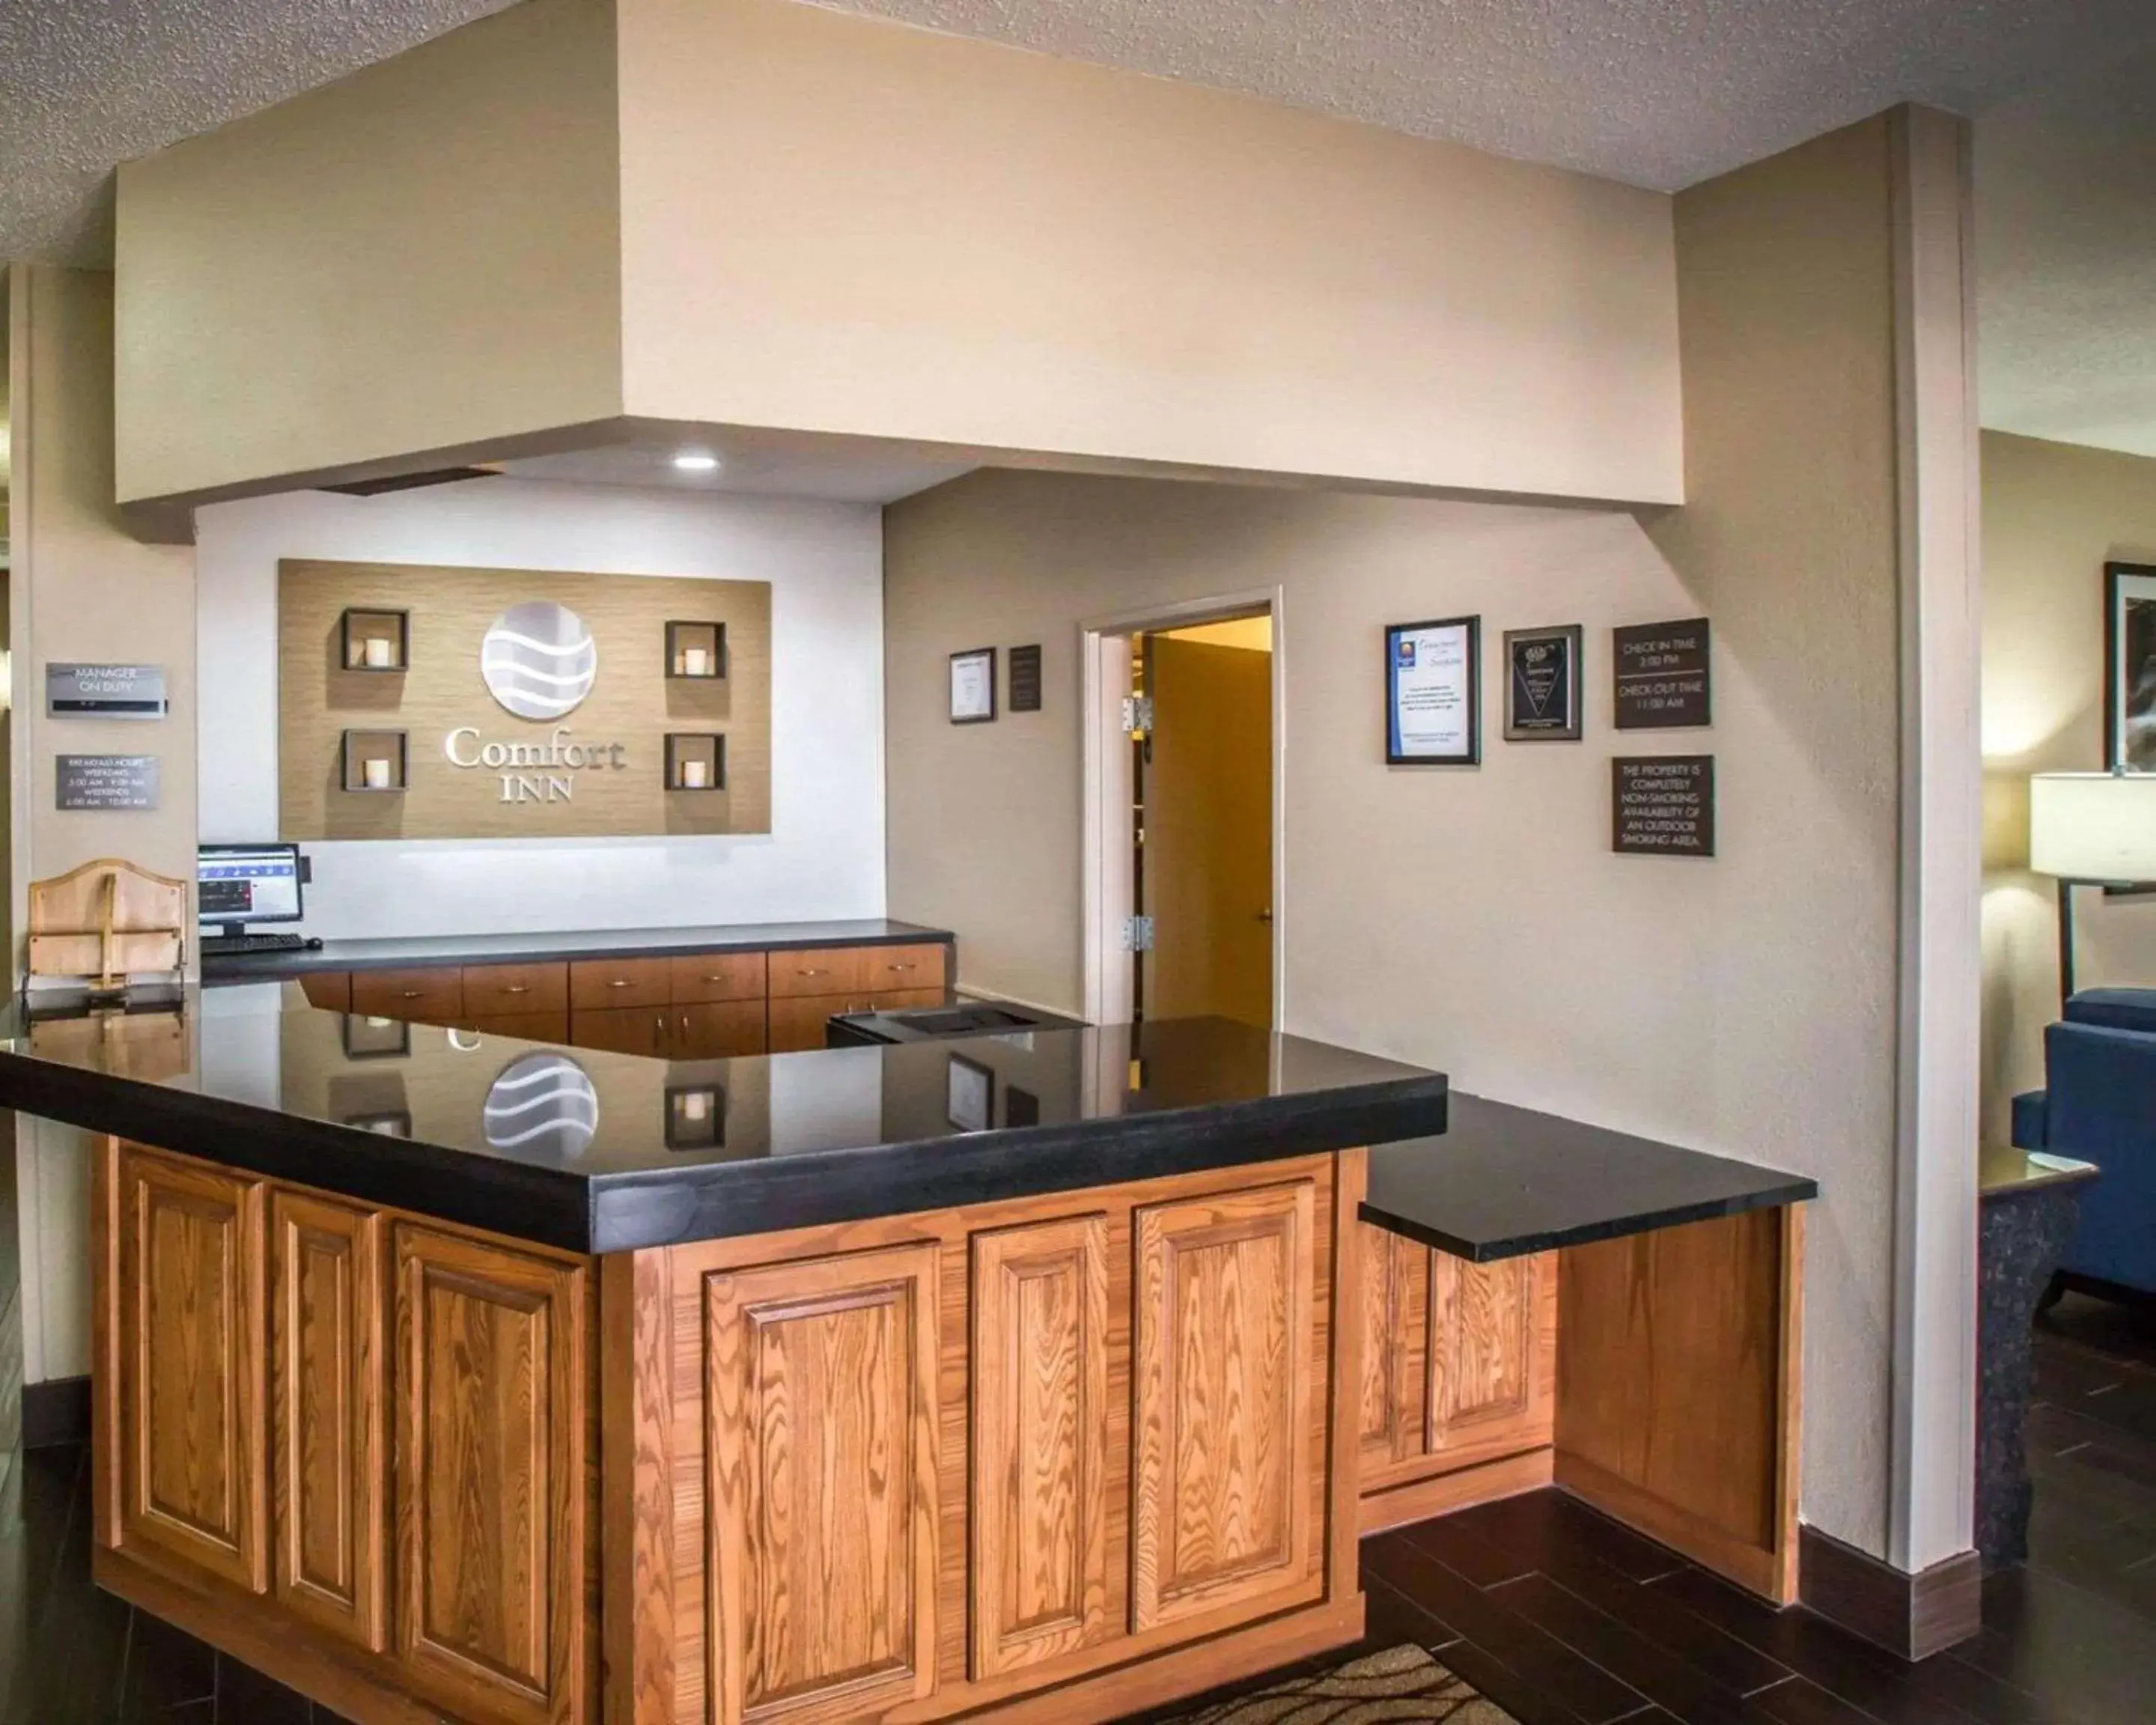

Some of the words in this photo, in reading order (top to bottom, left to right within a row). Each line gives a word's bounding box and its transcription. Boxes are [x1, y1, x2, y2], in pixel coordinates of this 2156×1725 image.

[1623, 642, 1656, 655] CHECK
[1659, 642, 1670, 651] IN
[1673, 638, 1696, 649] TIME
[1663, 654, 1679, 665] PM
[75, 668, 138, 678] MANAGER
[79, 681, 100, 692] ON
[103, 681, 134, 692] DUTY
[1618, 684, 1651, 697] CHECK
[1654, 683, 1675, 695] OUT
[1679, 681, 1702, 693] TIME
[1666, 697, 1684, 708] AM
[445, 725, 627, 770] Comfort
[499, 775, 573, 803] INN
[1630, 779, 1690, 790] COMPLETELY
[1627, 821, 1642, 830] AN
[1645, 821, 1696, 832] OUTDOOR
[1621, 834, 1669, 845] SMOKING
